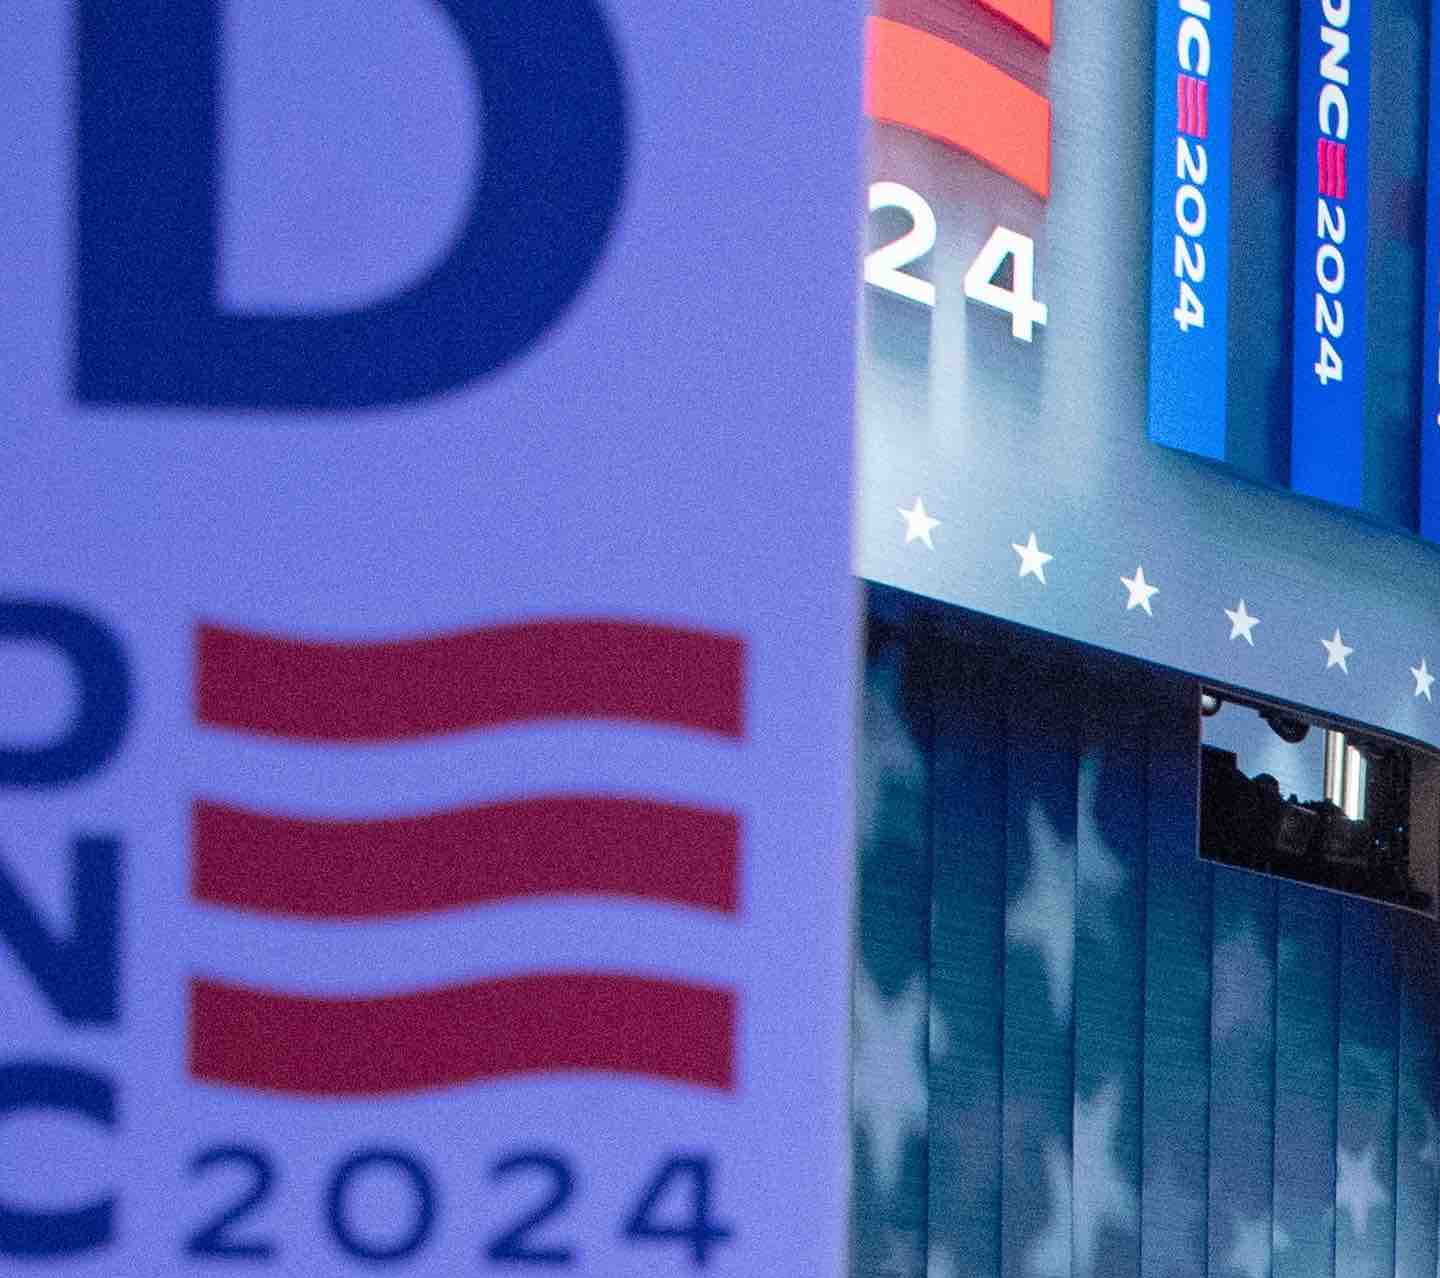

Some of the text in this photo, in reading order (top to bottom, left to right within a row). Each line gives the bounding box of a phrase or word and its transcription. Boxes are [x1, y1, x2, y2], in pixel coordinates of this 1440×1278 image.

[1173, 136, 1208, 332] 2024
[1314, 205, 1346, 386] 2024
[184, 1143, 735, 1270] 2024
